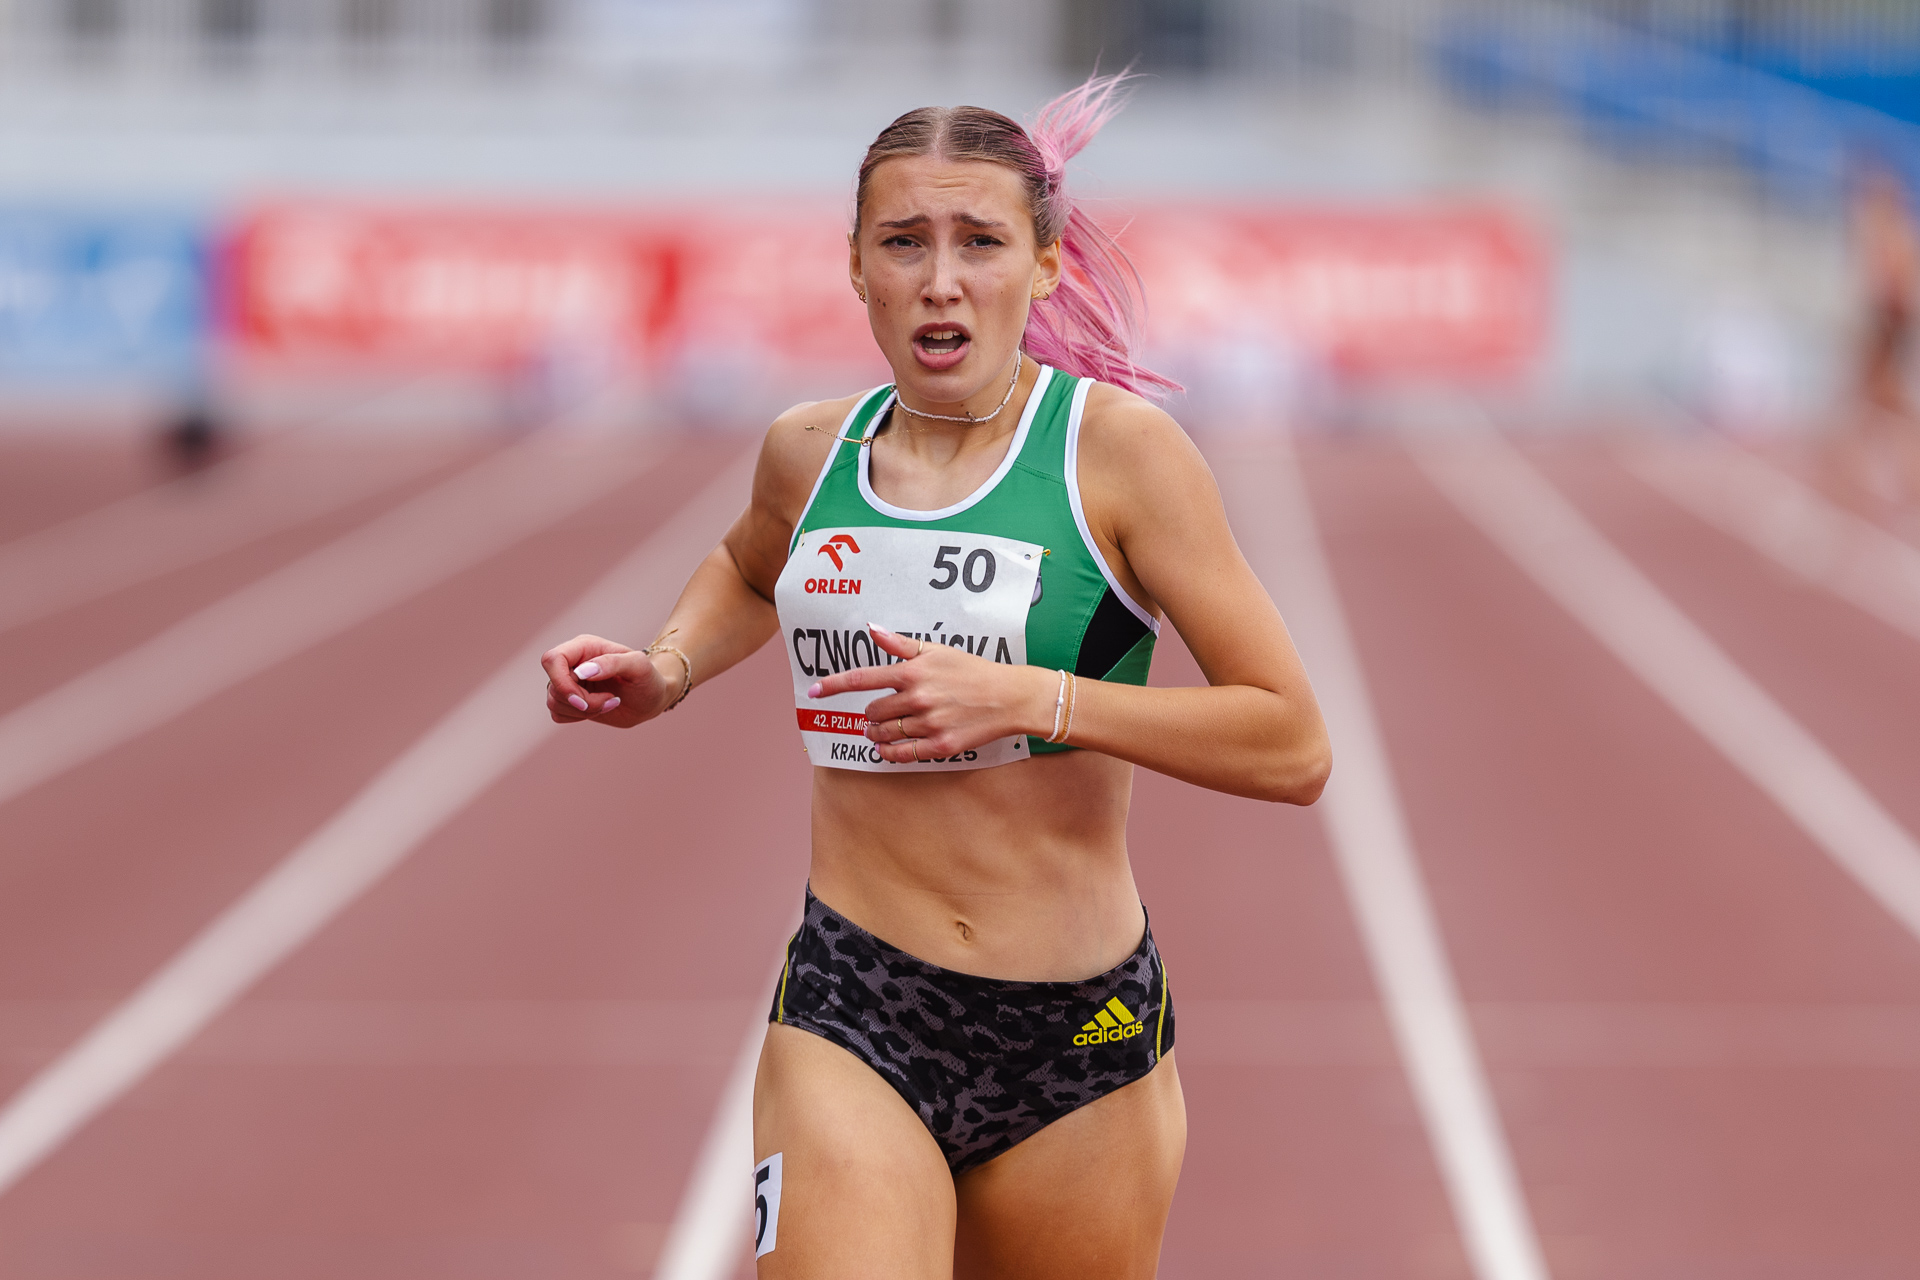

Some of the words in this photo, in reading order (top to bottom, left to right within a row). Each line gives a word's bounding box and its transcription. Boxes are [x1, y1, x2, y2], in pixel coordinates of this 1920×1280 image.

[929, 545, 997, 593] 50
[804, 578, 862, 595] ORLEN
[792, 621, 1013, 677] CZWOKA
[813, 714, 829, 728] 42.
[831, 715, 853, 730] PZLA
[830, 741, 897, 764] KRAKÓ
[917, 747, 978, 764] 25
[1072, 1020, 1144, 1047] adidas
